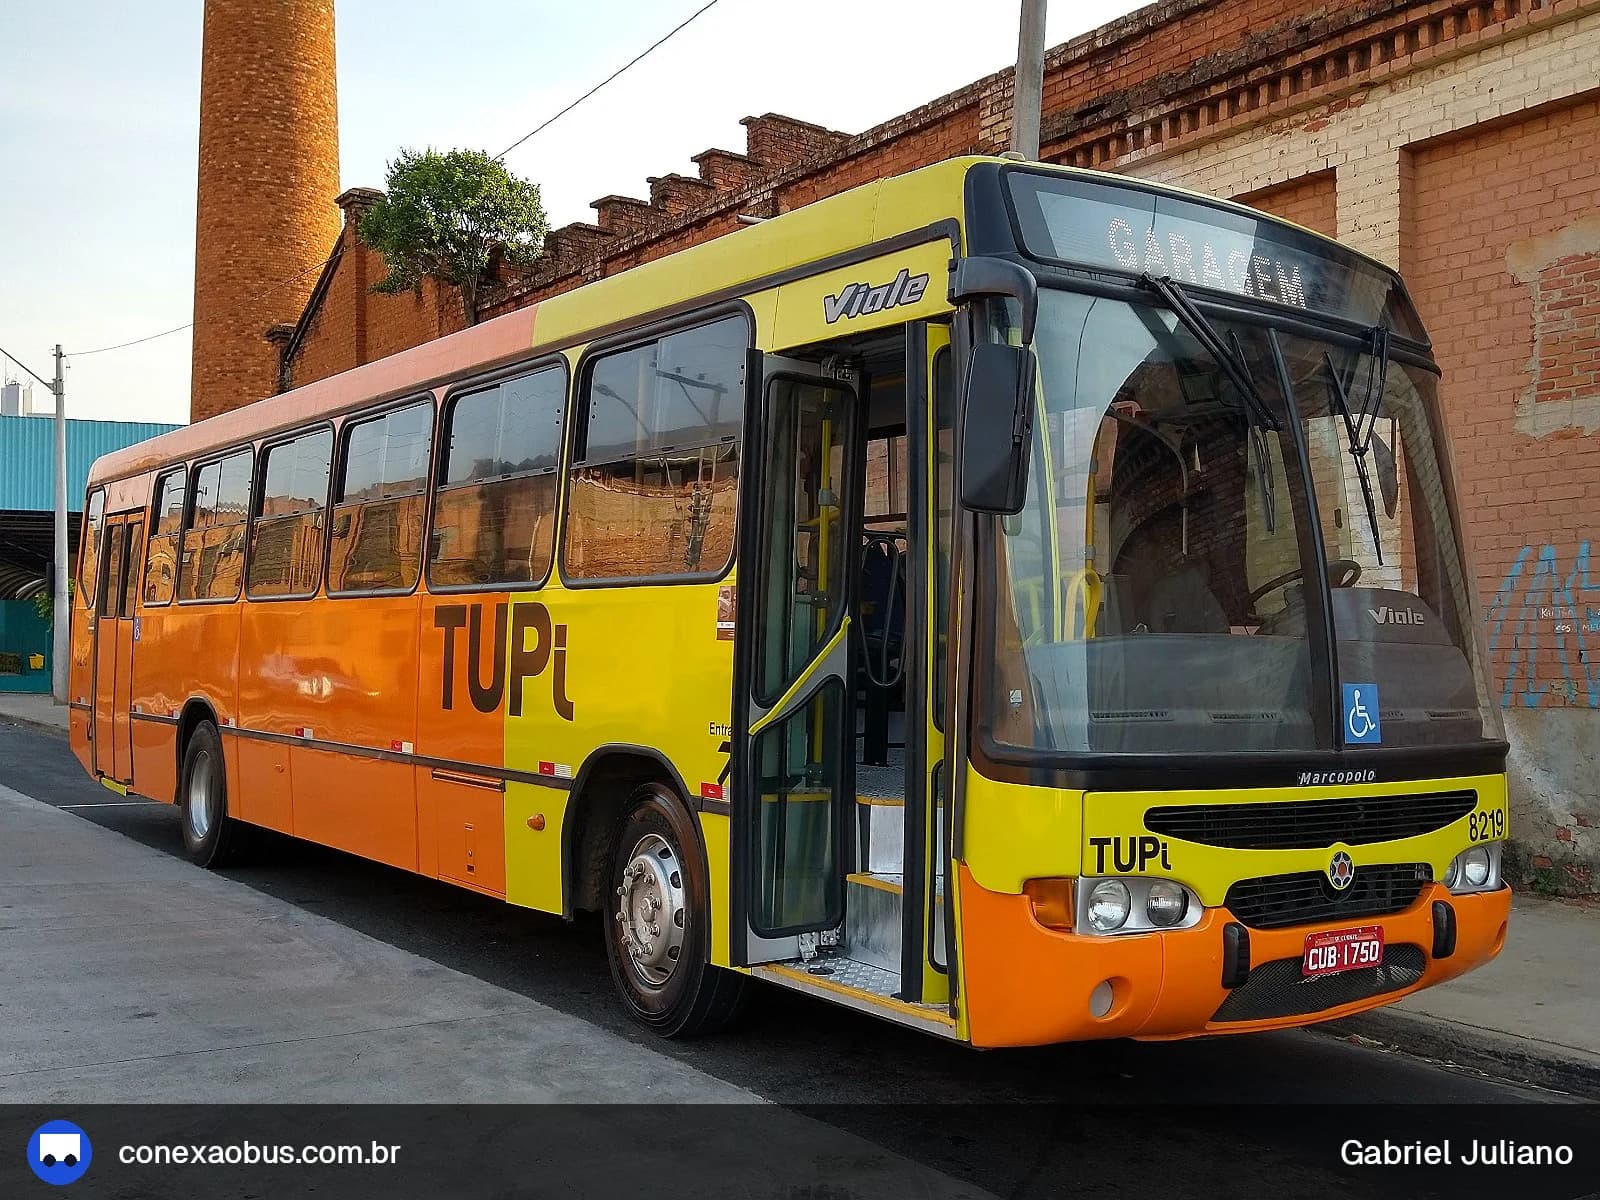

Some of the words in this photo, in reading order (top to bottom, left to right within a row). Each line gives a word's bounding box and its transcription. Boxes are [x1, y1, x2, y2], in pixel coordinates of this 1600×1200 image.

[1108, 217, 1307, 309] GARAGEM
[823, 268, 929, 324] Viale
[1368, 606, 1424, 625] Viale
[1299, 769, 1376, 785] Marcopolo
[1469, 808, 1504, 842] 8219
